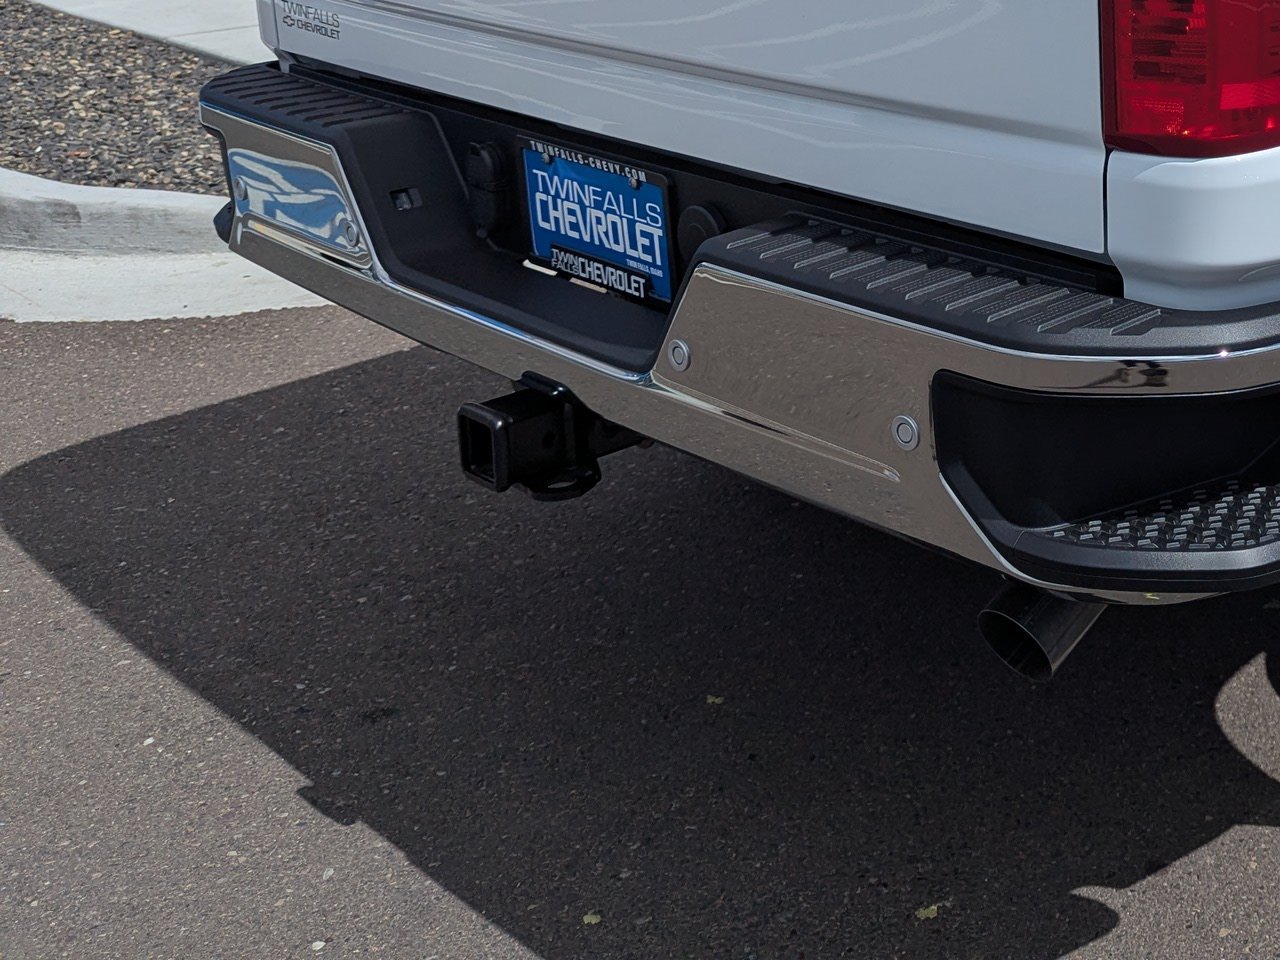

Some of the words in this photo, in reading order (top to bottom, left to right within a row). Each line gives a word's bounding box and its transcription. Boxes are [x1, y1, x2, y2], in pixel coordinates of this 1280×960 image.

[281, 0, 340, 28] TWINFALLS
[297, 19, 340, 40] CHEVROLET
[532, 168, 663, 228] TWINFALLS
[535, 191, 663, 266] CHEVROLET
[551, 248, 579, 266] TWIN
[551, 258, 579, 275] FALLS
[578, 257, 646, 298] CHEVROLET
